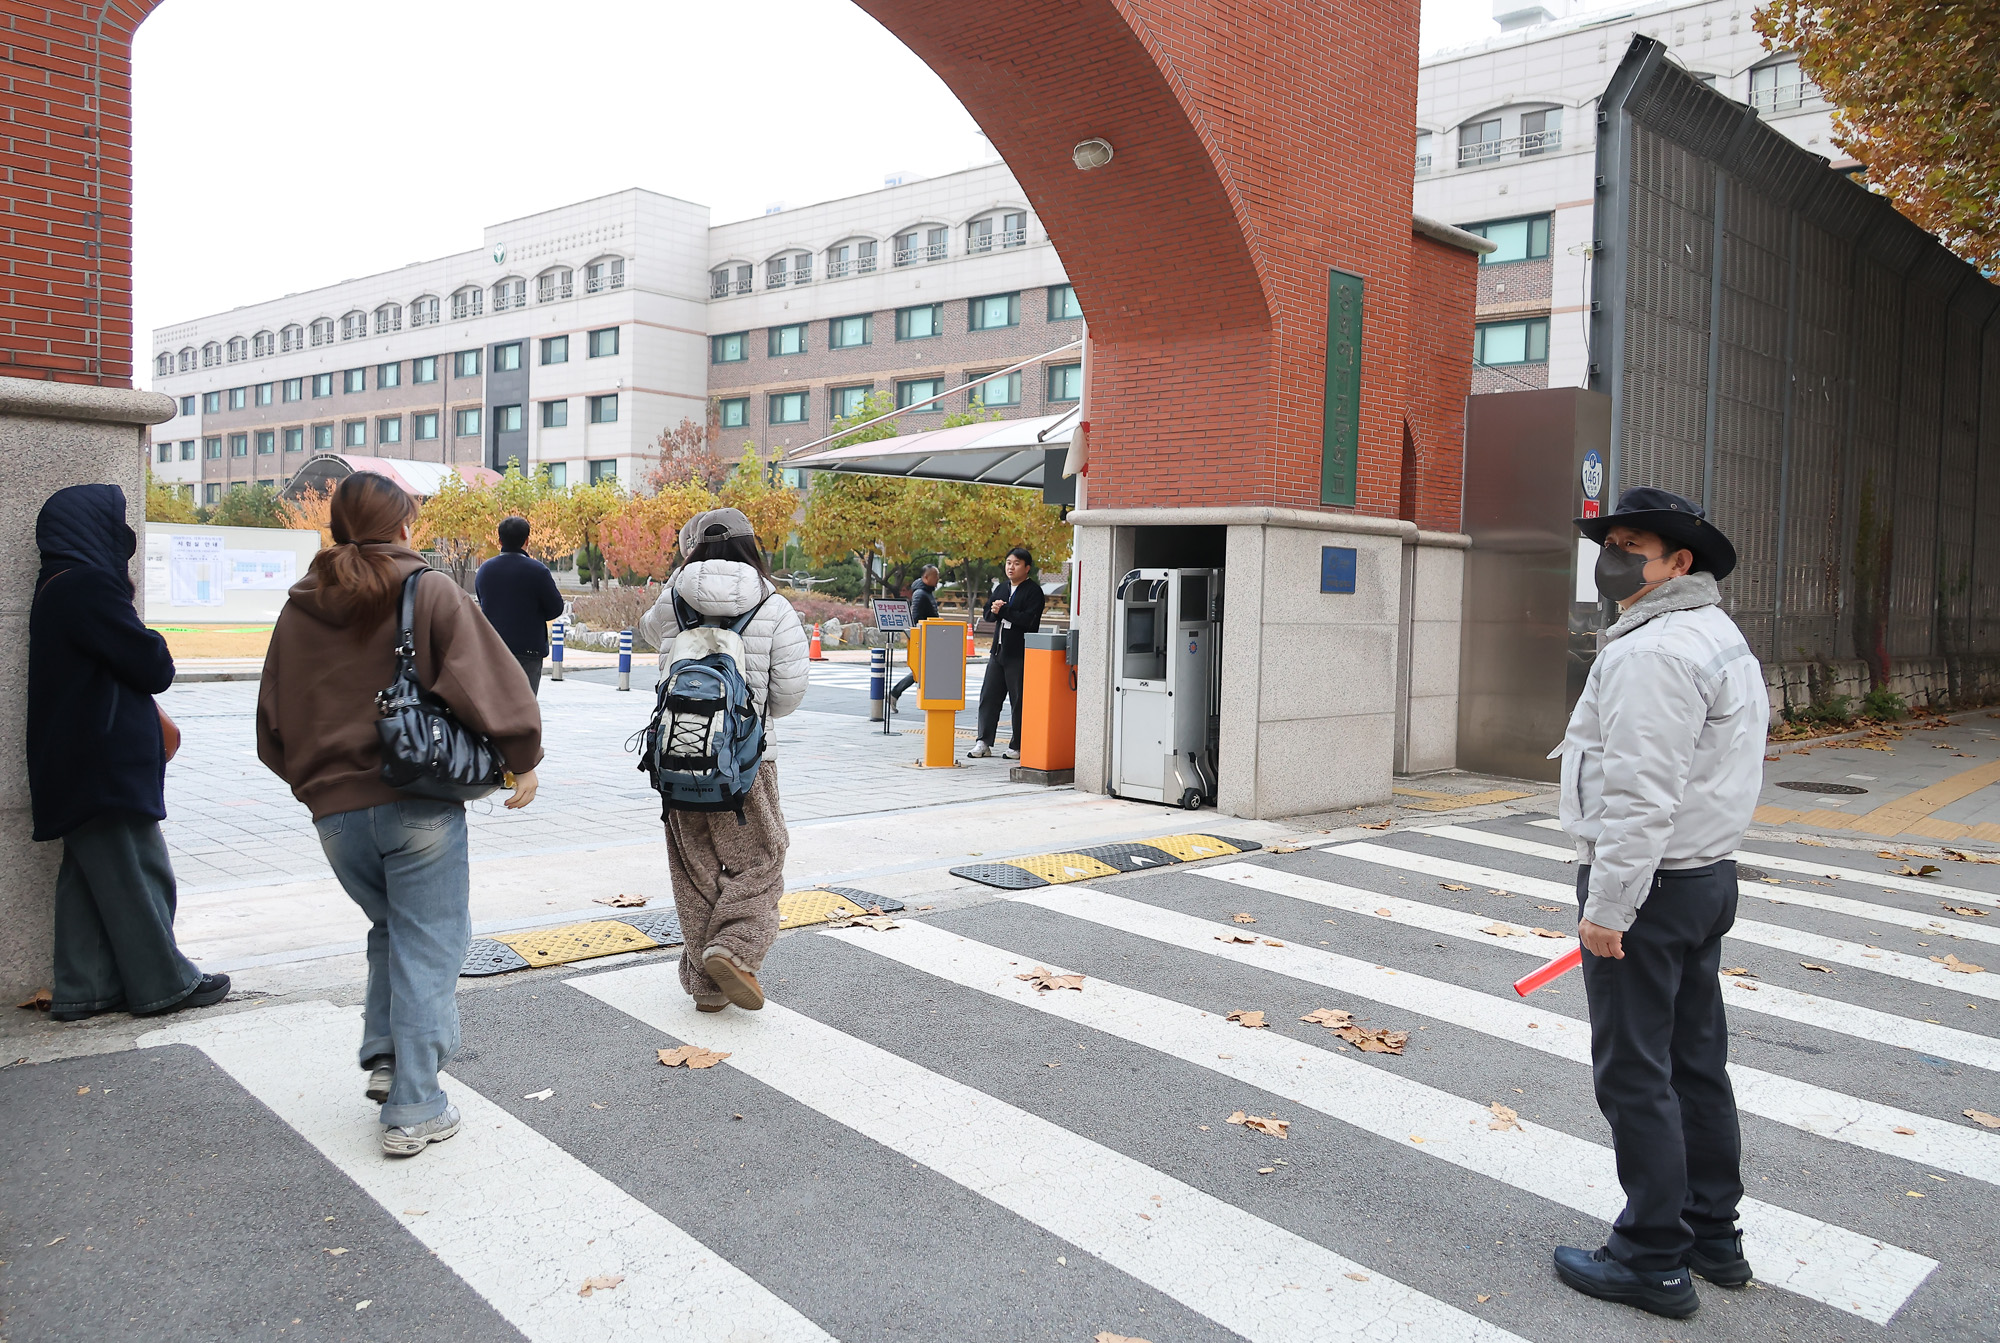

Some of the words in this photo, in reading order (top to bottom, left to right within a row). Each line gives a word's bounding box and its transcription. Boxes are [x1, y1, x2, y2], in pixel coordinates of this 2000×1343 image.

[1584, 469, 1600, 486] 1461
[877, 603, 907, 613] 학부모
[879, 614, 911, 627] 출입금지
[1662, 1278, 1681, 1287] MILLET
